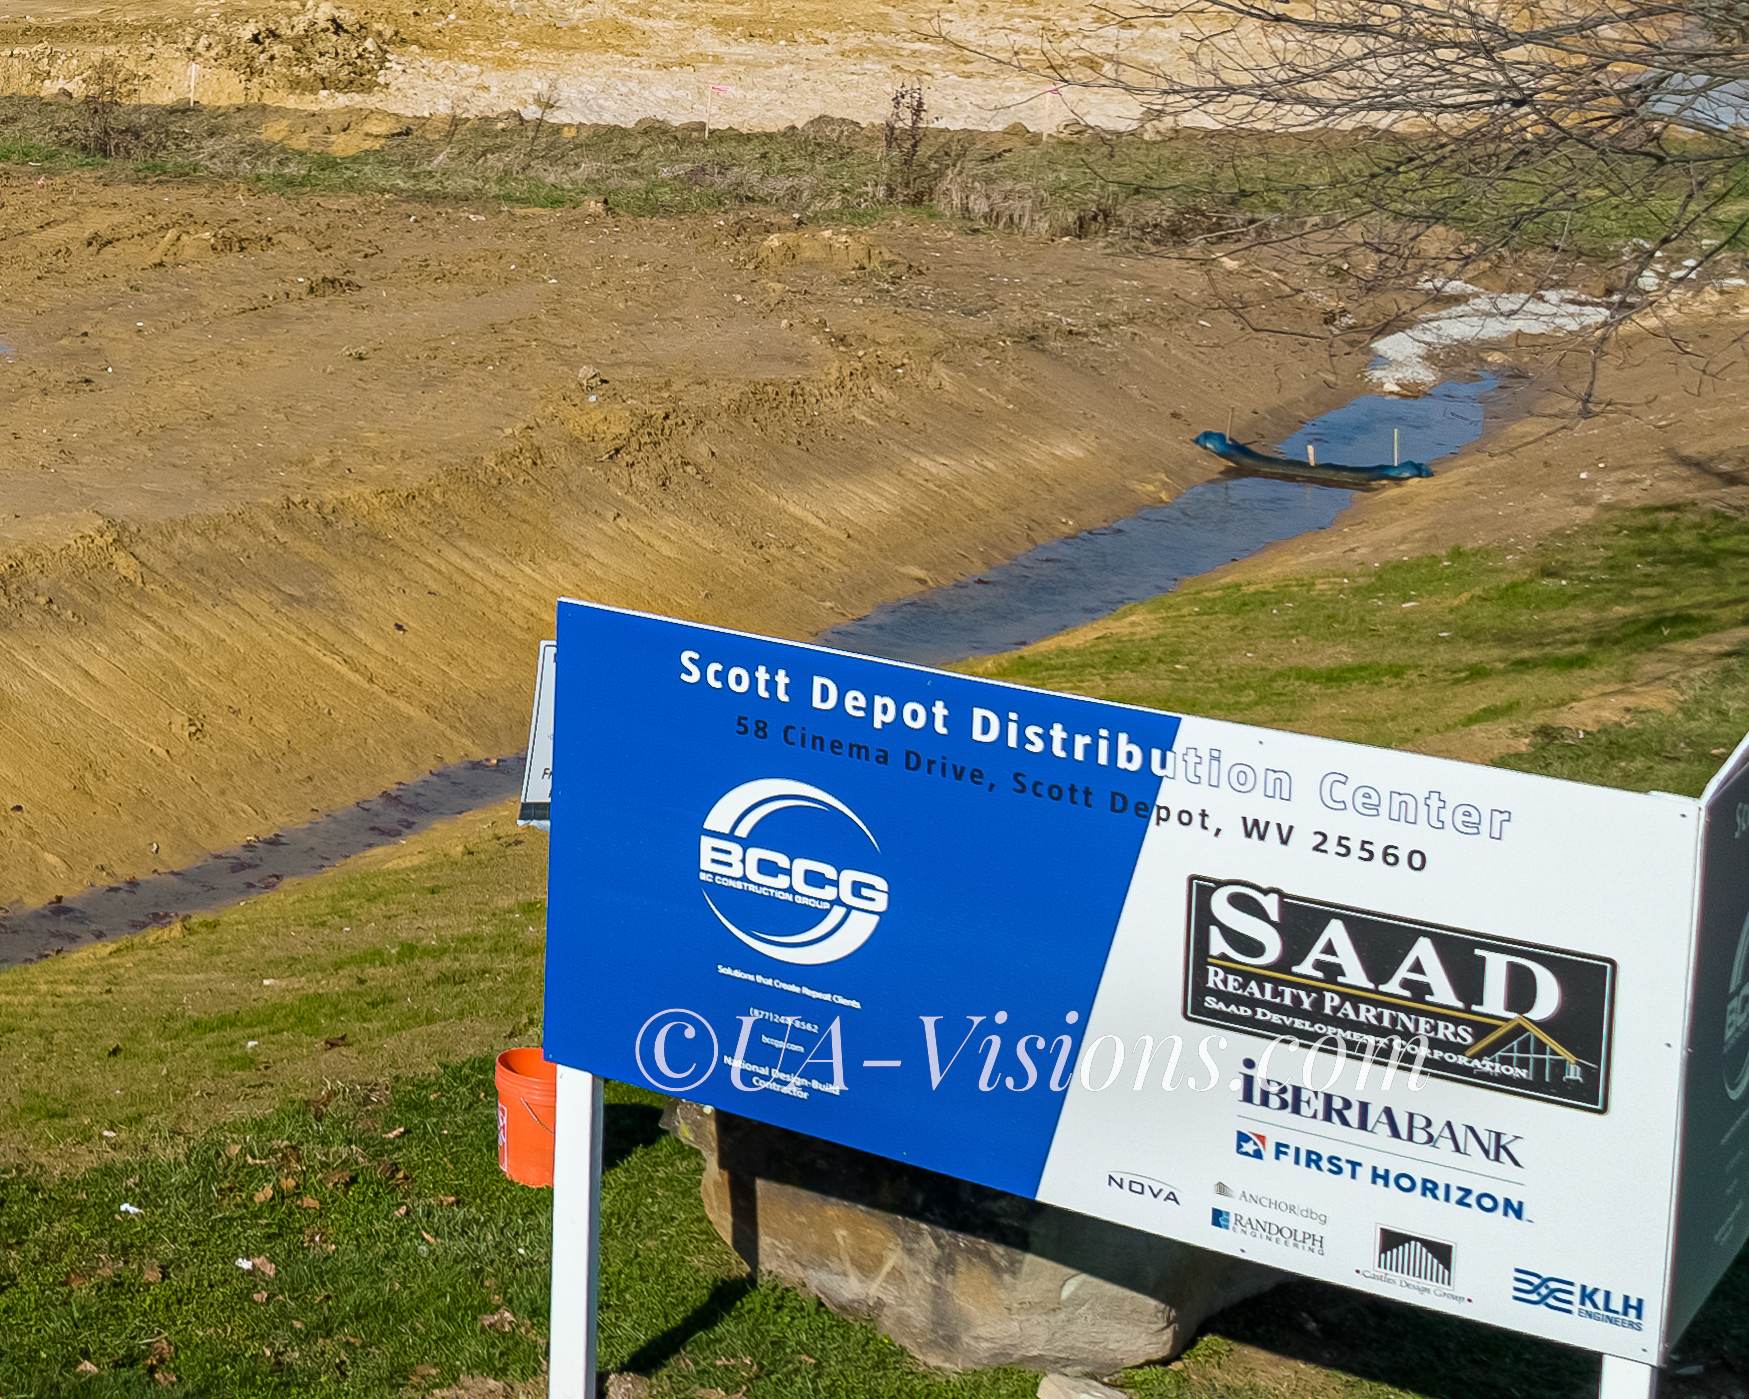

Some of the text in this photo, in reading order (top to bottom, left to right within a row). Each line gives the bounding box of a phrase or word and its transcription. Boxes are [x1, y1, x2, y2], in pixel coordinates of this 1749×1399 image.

[680, 650, 1513, 840] Scott Depot Distribution Center
[736, 715, 1427, 872] 58 Cinema Drive, Scott Depot, WV 25560
[699, 871, 831, 910] BC CONSTRUCTION GROUP
[700, 835, 889, 912] BCCG
[1208, 884, 1562, 1022] SAAD
[717, 964, 862, 1009] Solutions that Create Repeat Clients
[1205, 966, 1474, 1046] REALTY PARTNERS
[723, 1055, 841, 1096] National Design-Build
[752, 1076, 809, 1100] Contractor
[1107, 1174, 1181, 1205] NOVA
[1274, 1142, 1526, 1222] FIRST HORIZON
[1232, 1227, 1325, 1256] ENGINEERING
[1234, 1213, 1324, 1248] RANDOLPH
[1362, 1270, 1465, 1304] Castles Design Group
[1579, 1284, 1644, 1321] KLH
[1577, 1308, 1643, 1332] ENGINEERS
